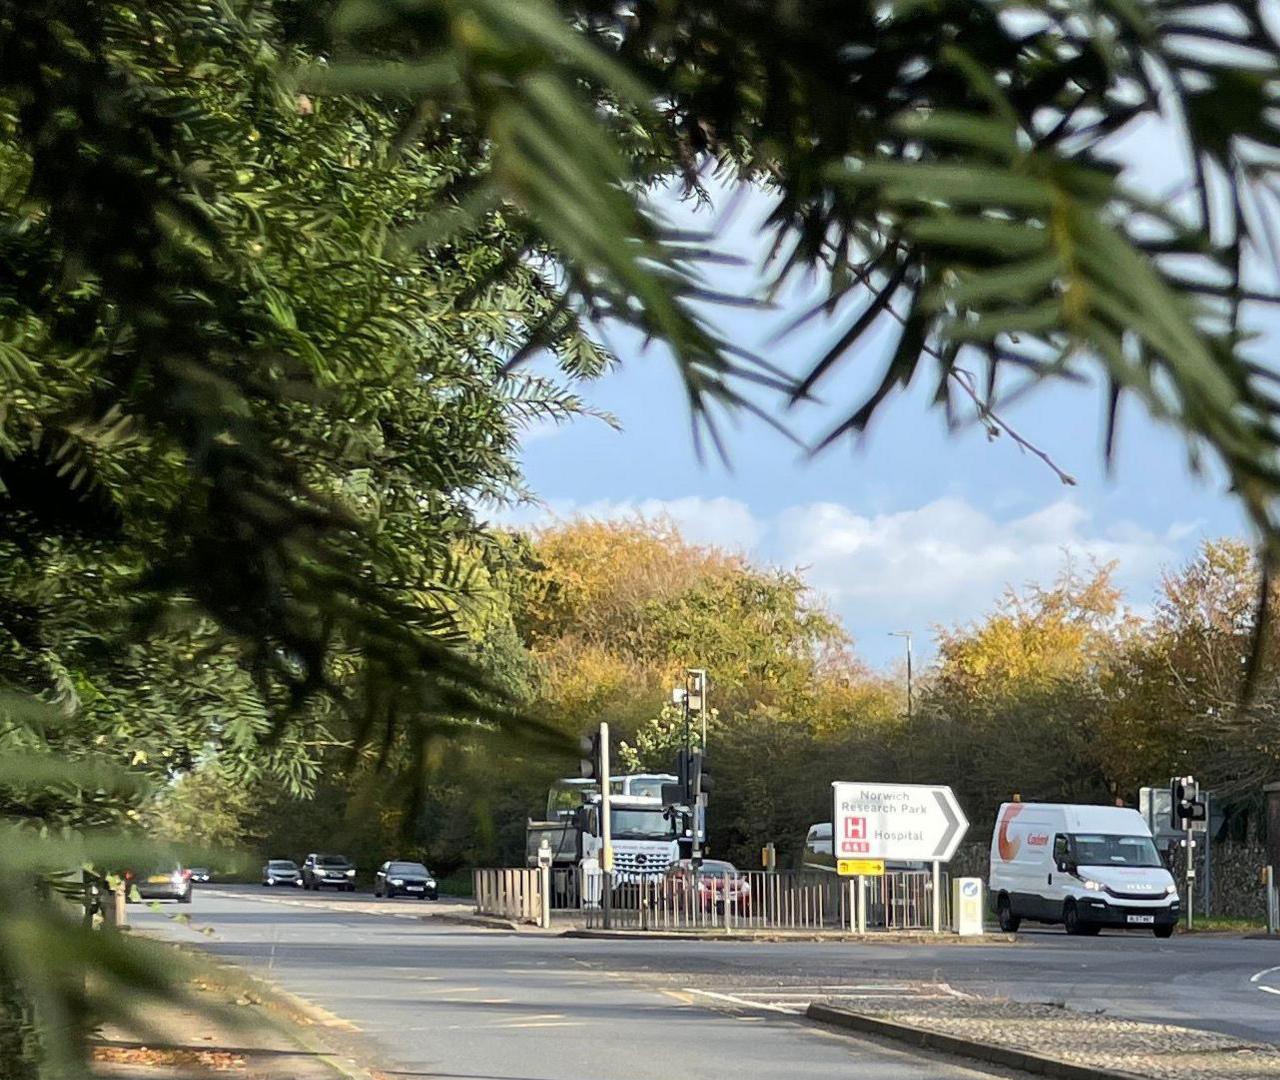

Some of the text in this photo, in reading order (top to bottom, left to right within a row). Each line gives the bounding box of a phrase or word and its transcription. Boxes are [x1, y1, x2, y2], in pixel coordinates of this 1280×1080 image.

[860, 790, 910, 801] Norwich
[841, 802, 927, 814] Research Park
[847, 817, 864, 838] H
[875, 830, 924, 842] Hospital
